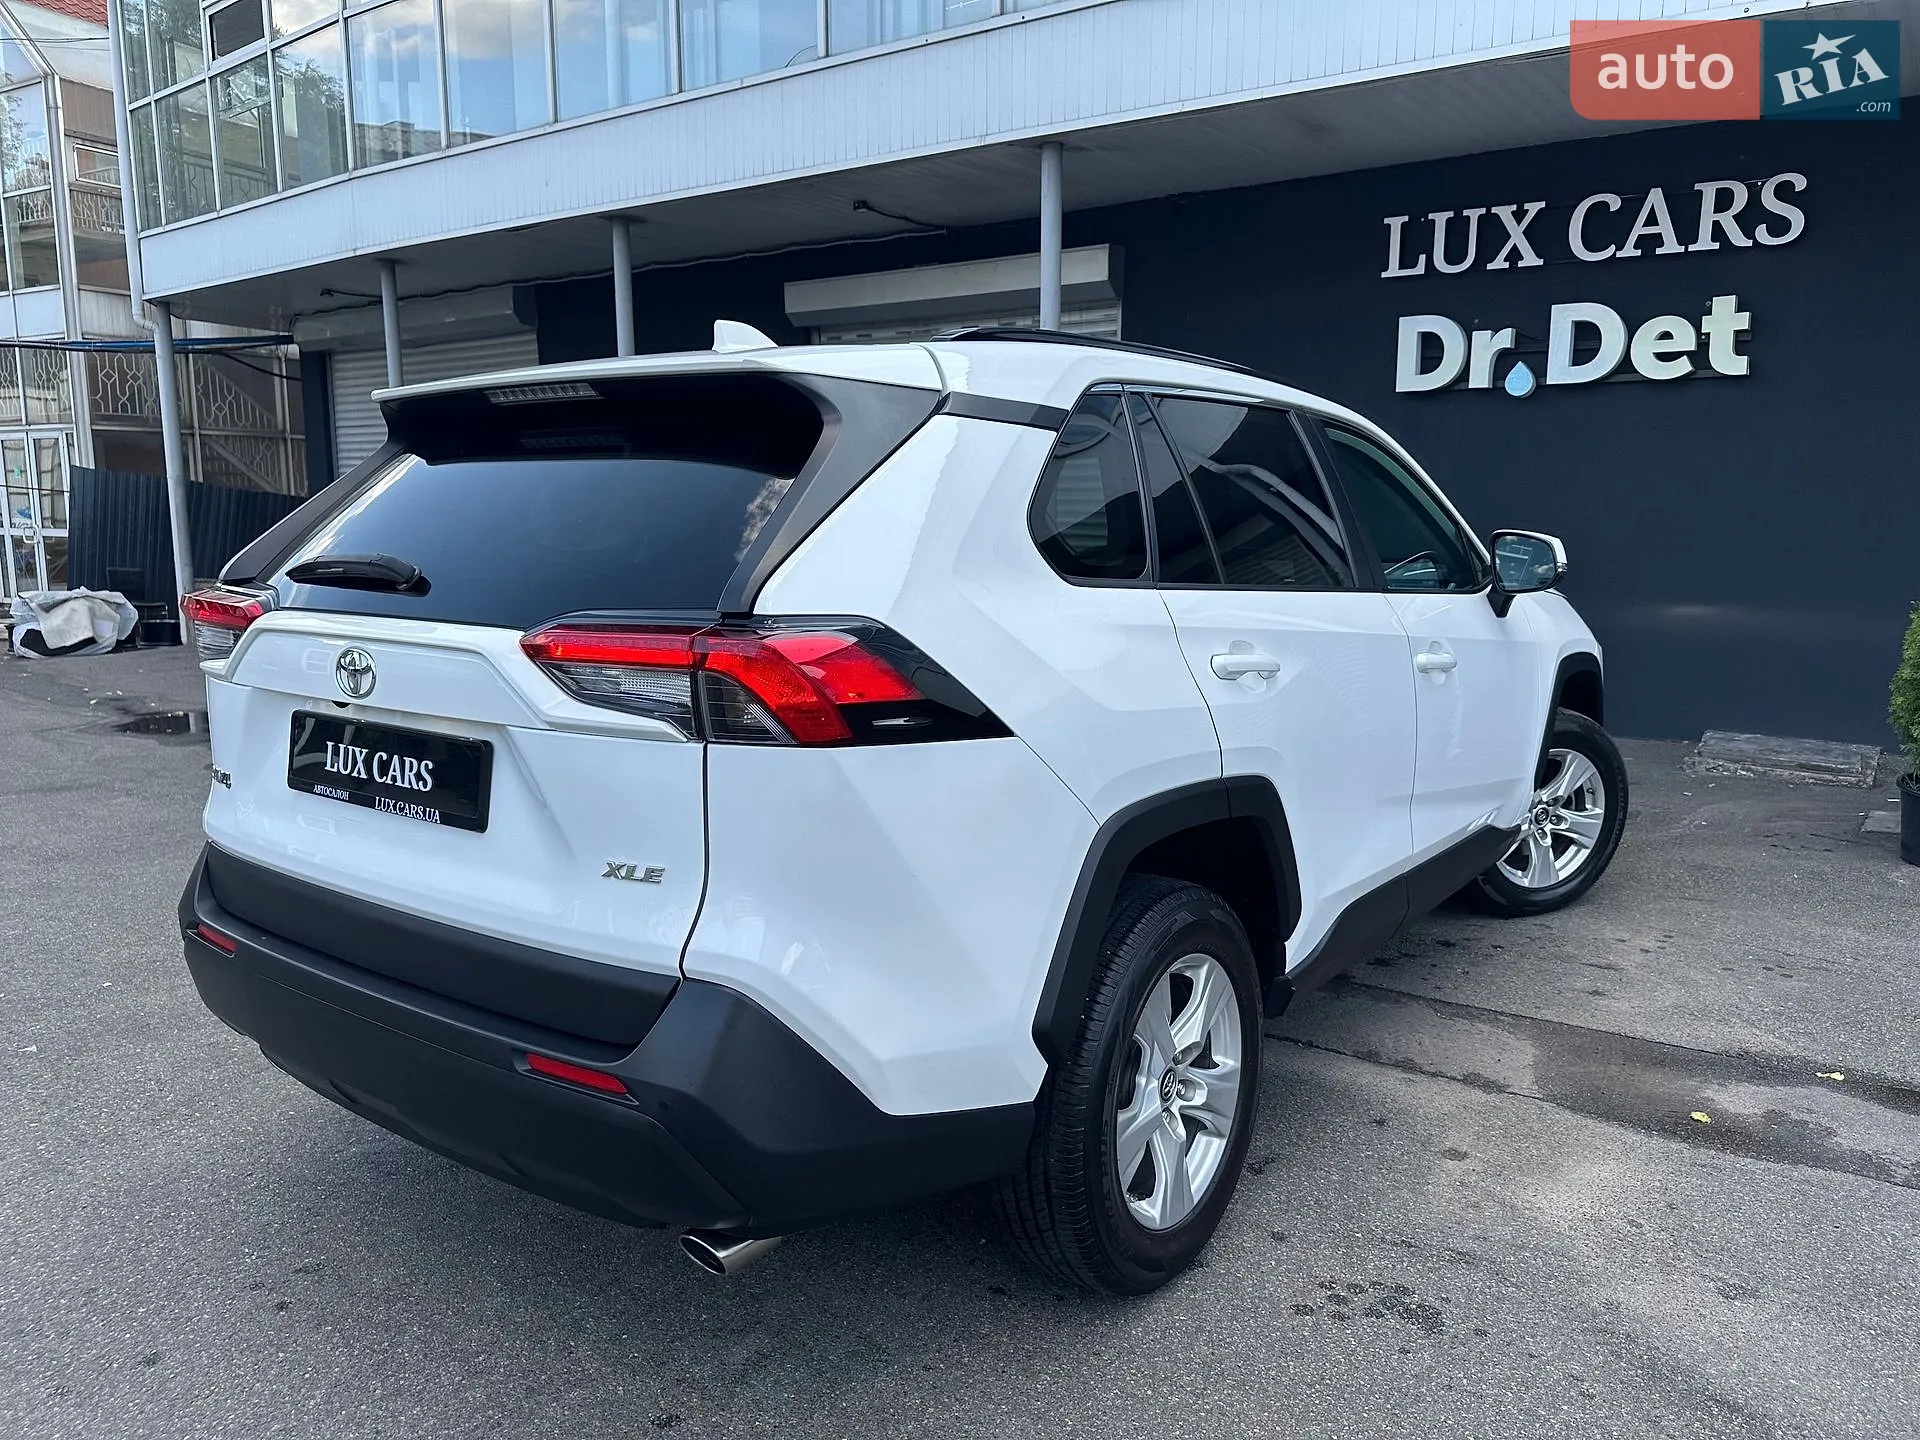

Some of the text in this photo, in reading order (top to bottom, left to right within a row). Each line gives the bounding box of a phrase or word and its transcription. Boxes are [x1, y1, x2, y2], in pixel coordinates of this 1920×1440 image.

[1381, 172, 1807, 278] LUX CARS
[324, 741, 434, 792] LUX CARS
[313, 784, 350, 800] АВТОСАЛОН
[375, 796, 441, 824] LUX.CARS.UA
[601, 860, 666, 884] XLE
